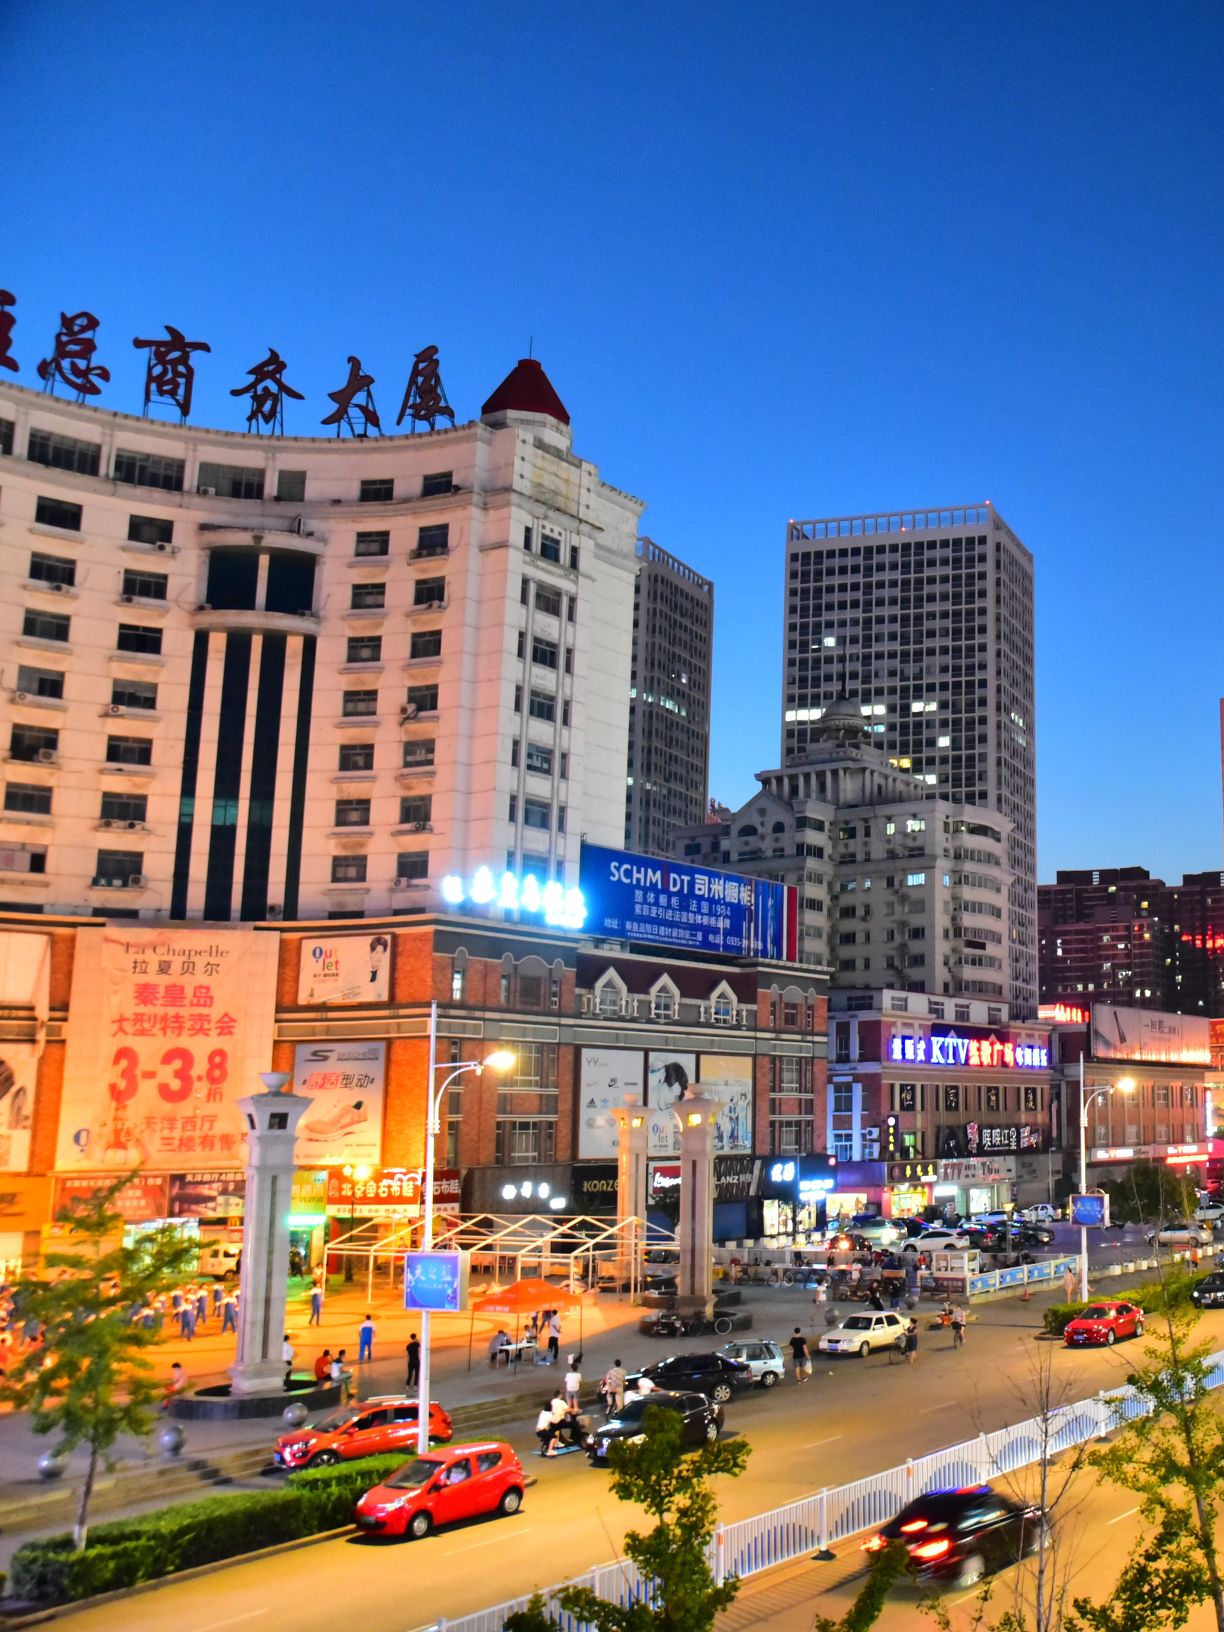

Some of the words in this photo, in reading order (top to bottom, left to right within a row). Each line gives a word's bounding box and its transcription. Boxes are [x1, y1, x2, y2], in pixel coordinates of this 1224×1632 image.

[609, 861, 691, 894] SCHMIDT
[152, 944, 230, 962] Chapelle
[131, 959, 221, 977] 拉夏贝尔
[133, 982, 214, 1008] 秦皇岛
[111, 1011, 238, 1038] 大型特卖会
[930, 1037, 969, 1064] KTV
